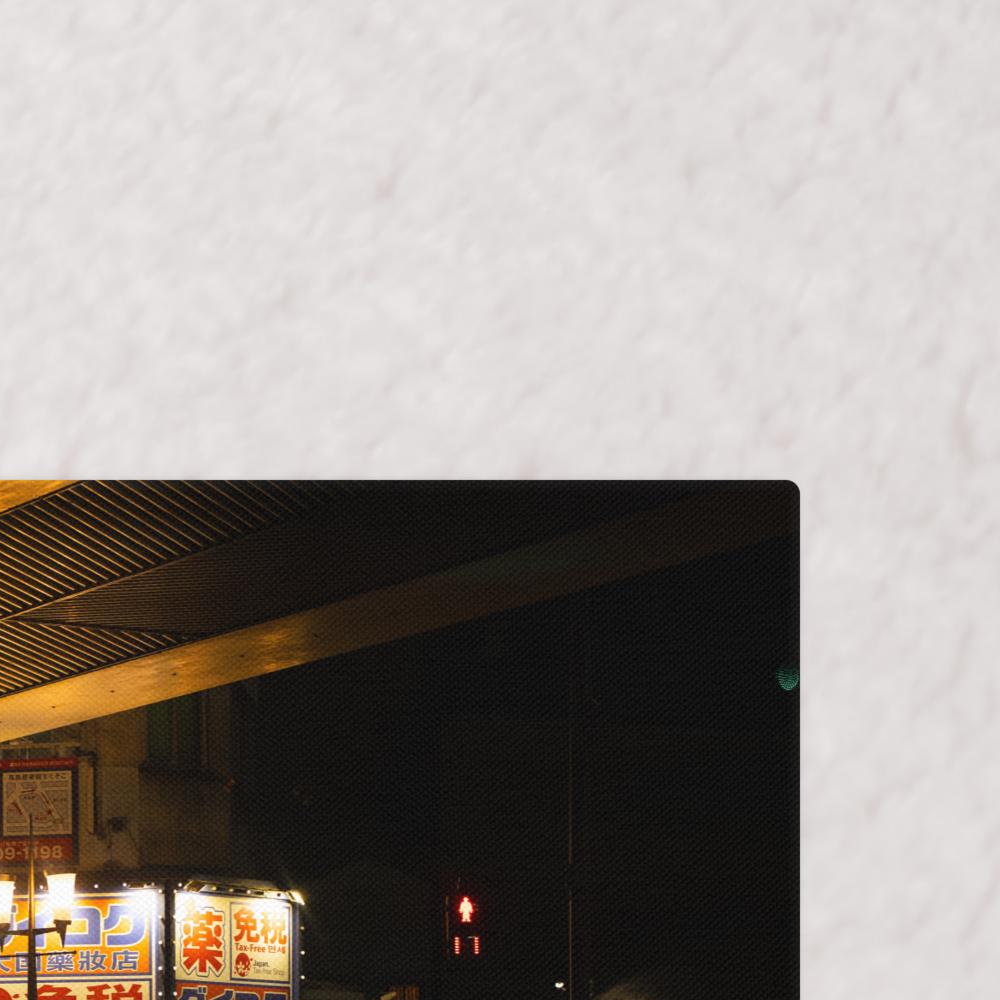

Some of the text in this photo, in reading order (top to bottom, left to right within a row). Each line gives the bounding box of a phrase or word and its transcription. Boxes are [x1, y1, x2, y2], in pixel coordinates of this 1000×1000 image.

[182, 911, 223, 973] 薬
[233, 907, 287, 945] 免税
[234, 943, 267, 953] Tax-Free
